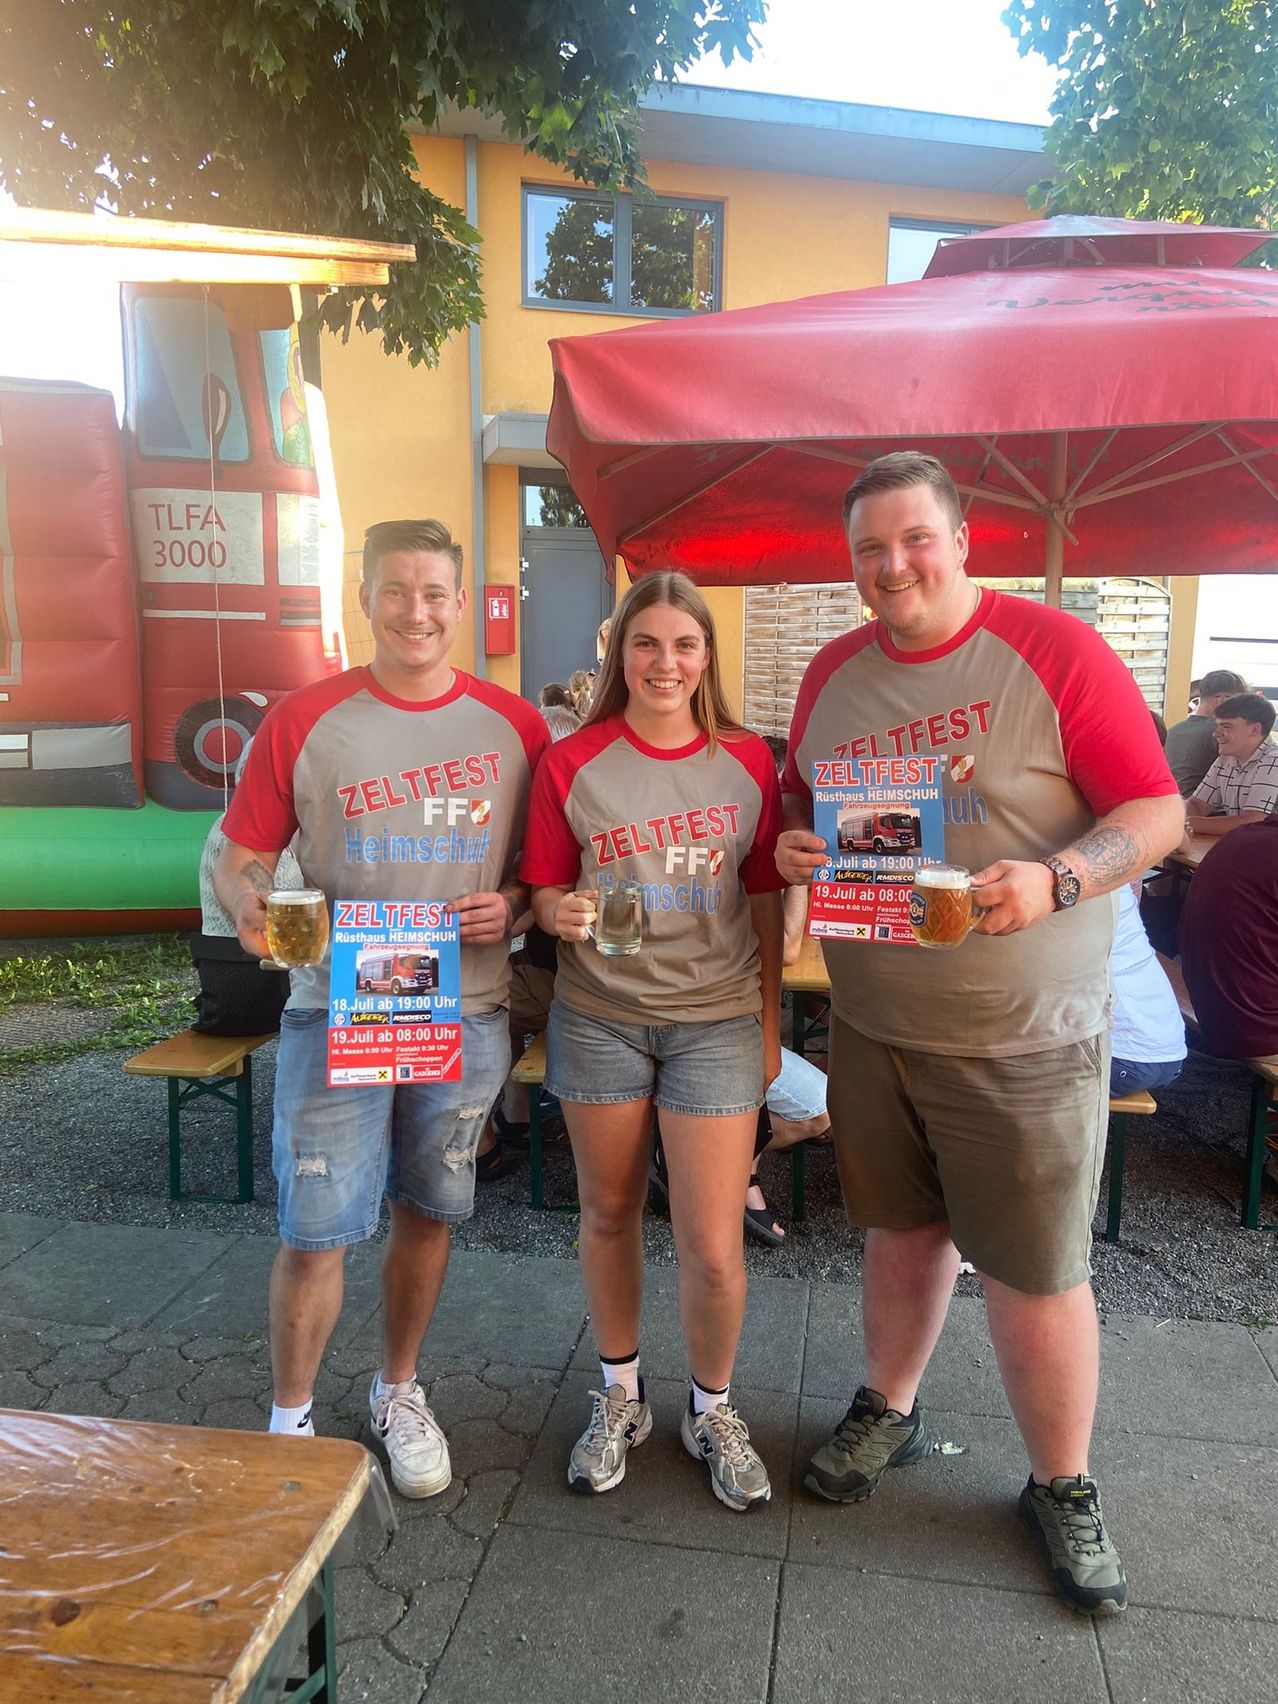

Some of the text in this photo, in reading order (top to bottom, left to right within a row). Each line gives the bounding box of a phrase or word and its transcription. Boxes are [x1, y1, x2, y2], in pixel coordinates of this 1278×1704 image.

[148, 504, 226, 532] TLFA
[153, 540, 227, 568] 3000
[815, 757, 938, 787] ZELTFEST
[337, 752, 500, 820] ZELTFEST
[816, 788, 938, 802] Rüsthaus HEIMSCHUH
[424, 798, 468, 825] FF
[590, 804, 739, 866] ZELTFEST
[665, 847, 708, 875] FF
[820, 856, 858, 869] 8.Juli
[861, 857, 876, 869] ab
[880, 856, 914, 869] 19:00
[815, 885, 856, 900] 19.Juli
[860, 888, 875, 901] ab
[336, 903, 453, 928] ZELTFEST
[824, 903, 845, 911] Messe
[877, 906, 902, 914] Festakt
[335, 930, 456, 943] Rüsthaus HEIMSCHUH
[332, 996, 457, 1012] 18.Juli ab 19:00 Uhr
[332, 1027, 458, 1044] 19.Juli ab 08:00 Uhr
[396, 1045, 420, 1053] Festakt
